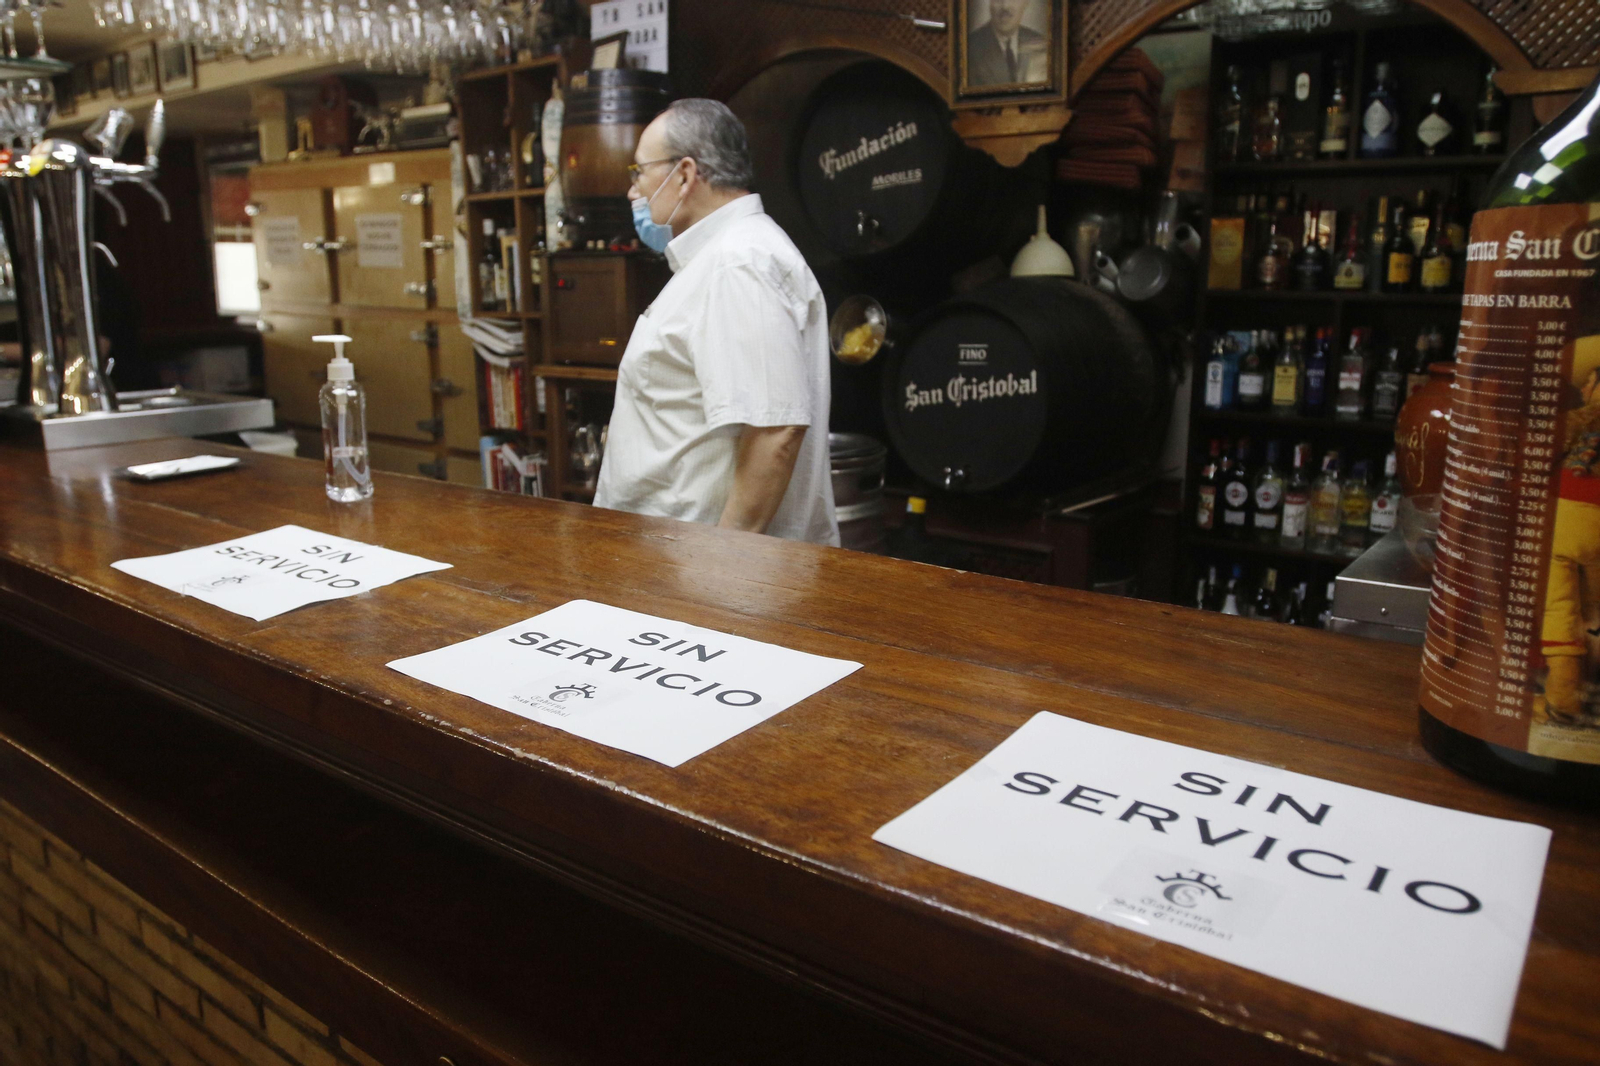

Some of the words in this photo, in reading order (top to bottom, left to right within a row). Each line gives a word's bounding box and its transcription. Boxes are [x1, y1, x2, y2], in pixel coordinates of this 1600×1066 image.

[819, 121, 918, 179] Fundación
[1505, 230, 1561, 261] San
[1494, 269, 1514, 278] CASA
[1514, 269, 1553, 278] FUNDADA
[1555, 269, 1569, 278] EN
[1571, 269, 1596, 278] 1967
[1470, 294, 1495, 307] TAPAS
[1498, 295, 1515, 308] EN
[1518, 295, 1572, 309] BARRA
[1538, 321, 1558, 330] 3,00
[1559, 322, 1566, 330] €
[1537, 335, 1556, 345] 3,00
[1557, 336, 1564, 344] €
[959, 348, 988, 361] FINO
[1534, 350, 1555, 359] 4,00
[1556, 350, 1563, 359] €
[1534, 363, 1554, 373] 3,50
[1532, 377, 1552, 387] 3,50
[1553, 379, 1560, 387] €
[904, 382, 943, 412] San
[946, 368, 1037, 408] Cristobal
[1531, 391, 1551, 401] 3,50
[1552, 393, 1559, 401] €
[1529, 405, 1549, 415] 3,50
[1550, 407, 1557, 415] €
[1528, 419, 1548, 429] 3,50
[1549, 421, 1555, 429] €
[1526, 432, 1546, 442] 3,50
[1547, 435, 1554, 443] €
[1523, 446, 1544, 456] 6,00
[1545, 449, 1552, 457] €
[1524, 460, 1543, 470] 3,50
[1544, 463, 1551, 471] €
[1521, 473, 1541, 483] 2,50
[1520, 487, 1540, 497] 3,50
[1541, 490, 1548, 498] €
[1518, 500, 1538, 510] 2,25
[1517, 513, 1537, 524] 3,50
[1538, 517, 1545, 525] €
[1516, 527, 1535, 537] 3,00
[1536, 530, 1543, 538] €
[1515, 540, 1534, 550] 3,00
[1535, 544, 1542, 552] €
[301, 545, 366, 564] SIN
[1513, 553, 1532, 563] 3,50
[1533, 557, 1540, 565] €
[215, 546, 361, 589] SERVICIO
[1511, 566, 1530, 577] 2,75
[1531, 570, 1539, 578] €
[1510, 579, 1529, 590] 3,50
[1530, 583, 1537, 591] €
[1509, 592, 1528, 603] 3,50
[1507, 605, 1526, 616] 3,50
[1506, 618, 1525, 629] 3,50
[1504, 631, 1523, 641] 3,50
[628, 632, 728, 663] SIN
[1523, 648, 1529, 656] €
[508, 631, 763, 708] SERVICIO
[1521, 661, 1527, 669] €
[1172, 771, 1335, 826] SIN
[1002, 771, 1483, 915] SERVICIO
